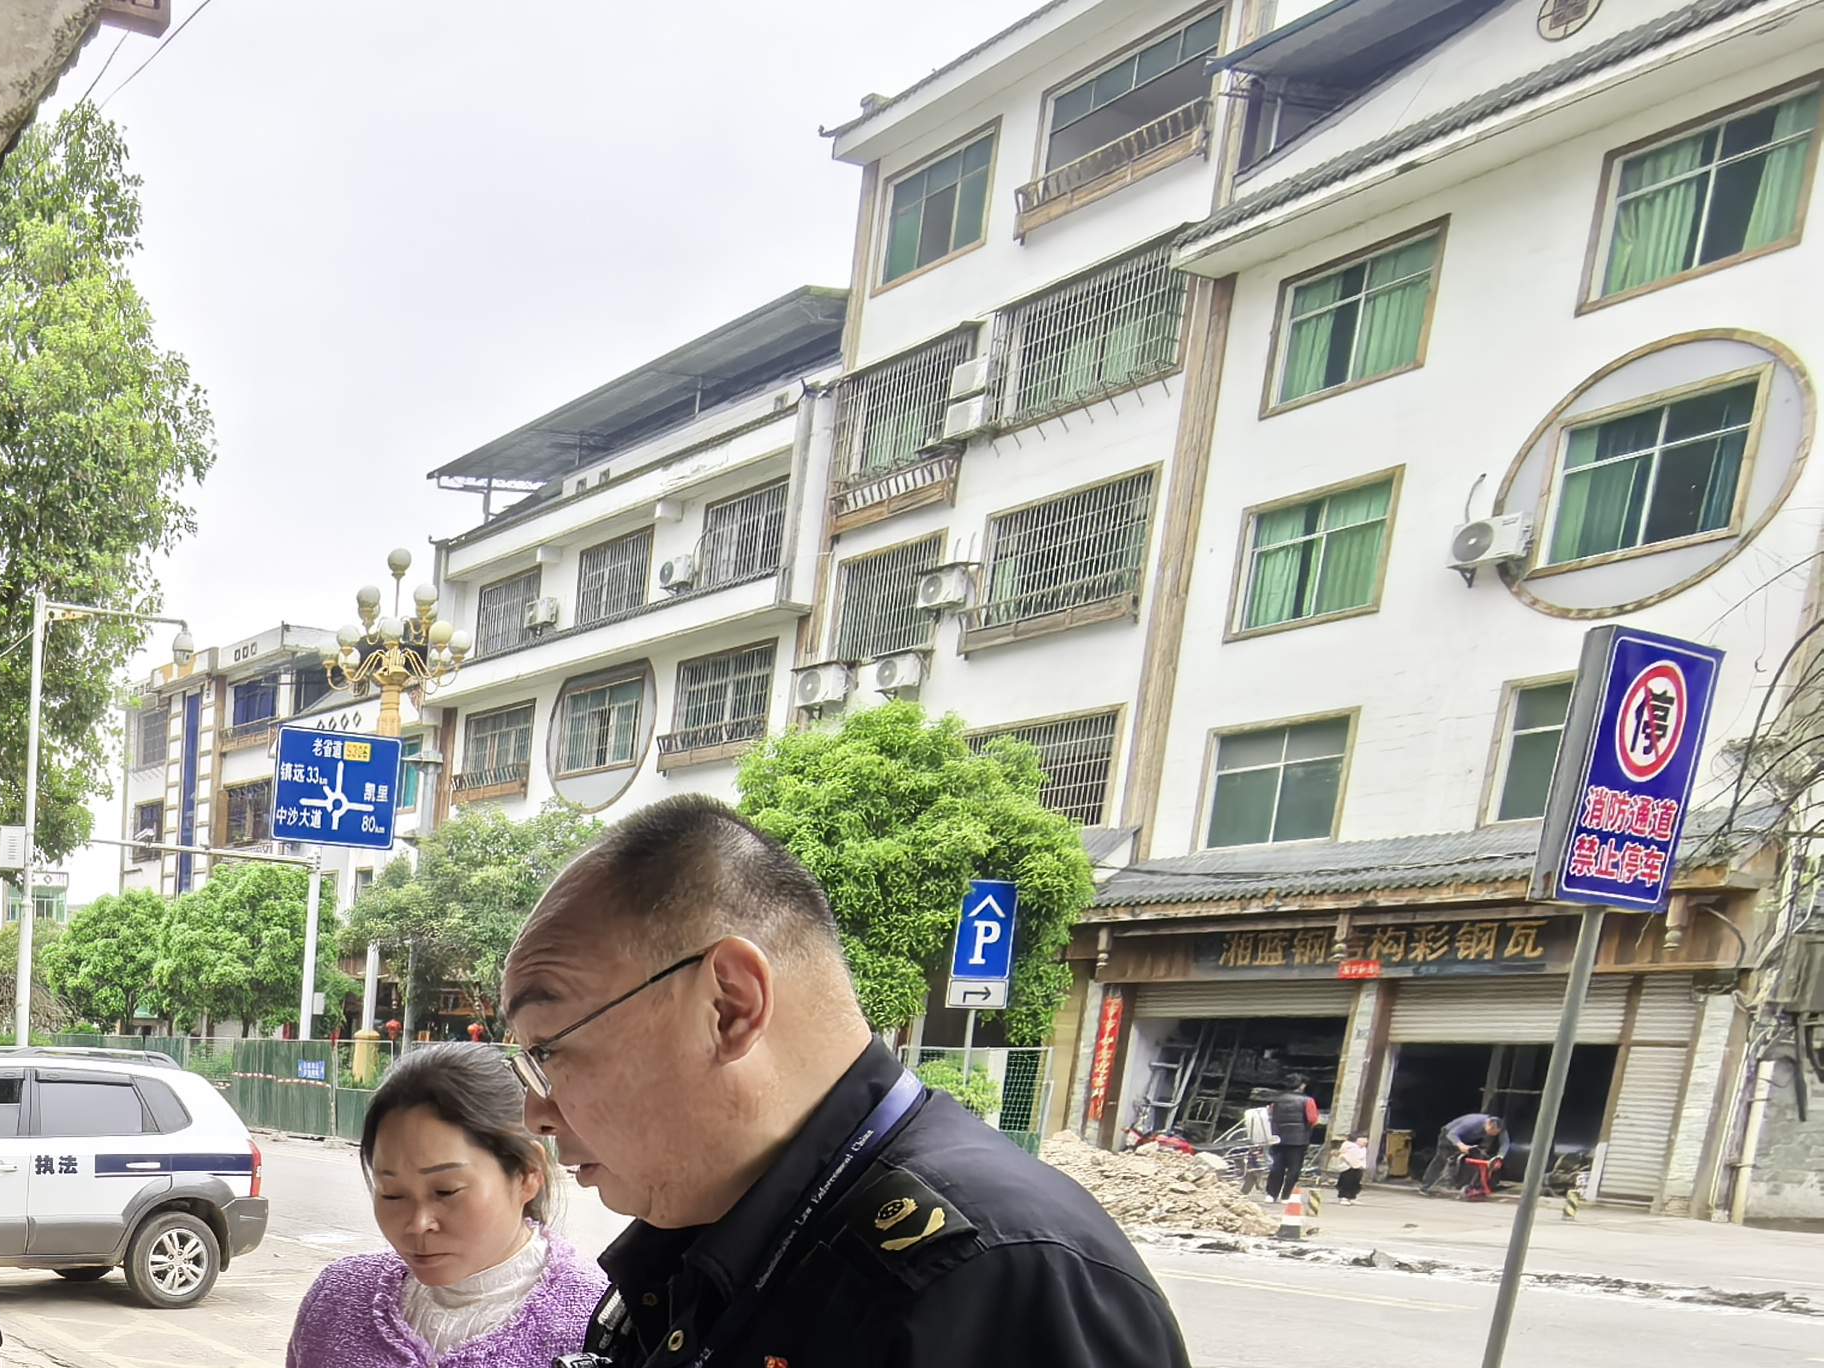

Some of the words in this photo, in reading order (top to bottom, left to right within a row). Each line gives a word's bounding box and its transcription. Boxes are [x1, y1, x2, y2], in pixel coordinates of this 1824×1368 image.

[1630, 687, 1676, 756] 停
[312, 738, 344, 760] 老省道
[276, 806, 322, 829] 中沙大道
[1580, 786, 1679, 840] 消防通道
[1570, 833, 1666, 887] 禁止停车
[968, 920, 1002, 964] P
[851, 1129, 875, 1152] China
[35, 1155, 78, 1175] 执法
